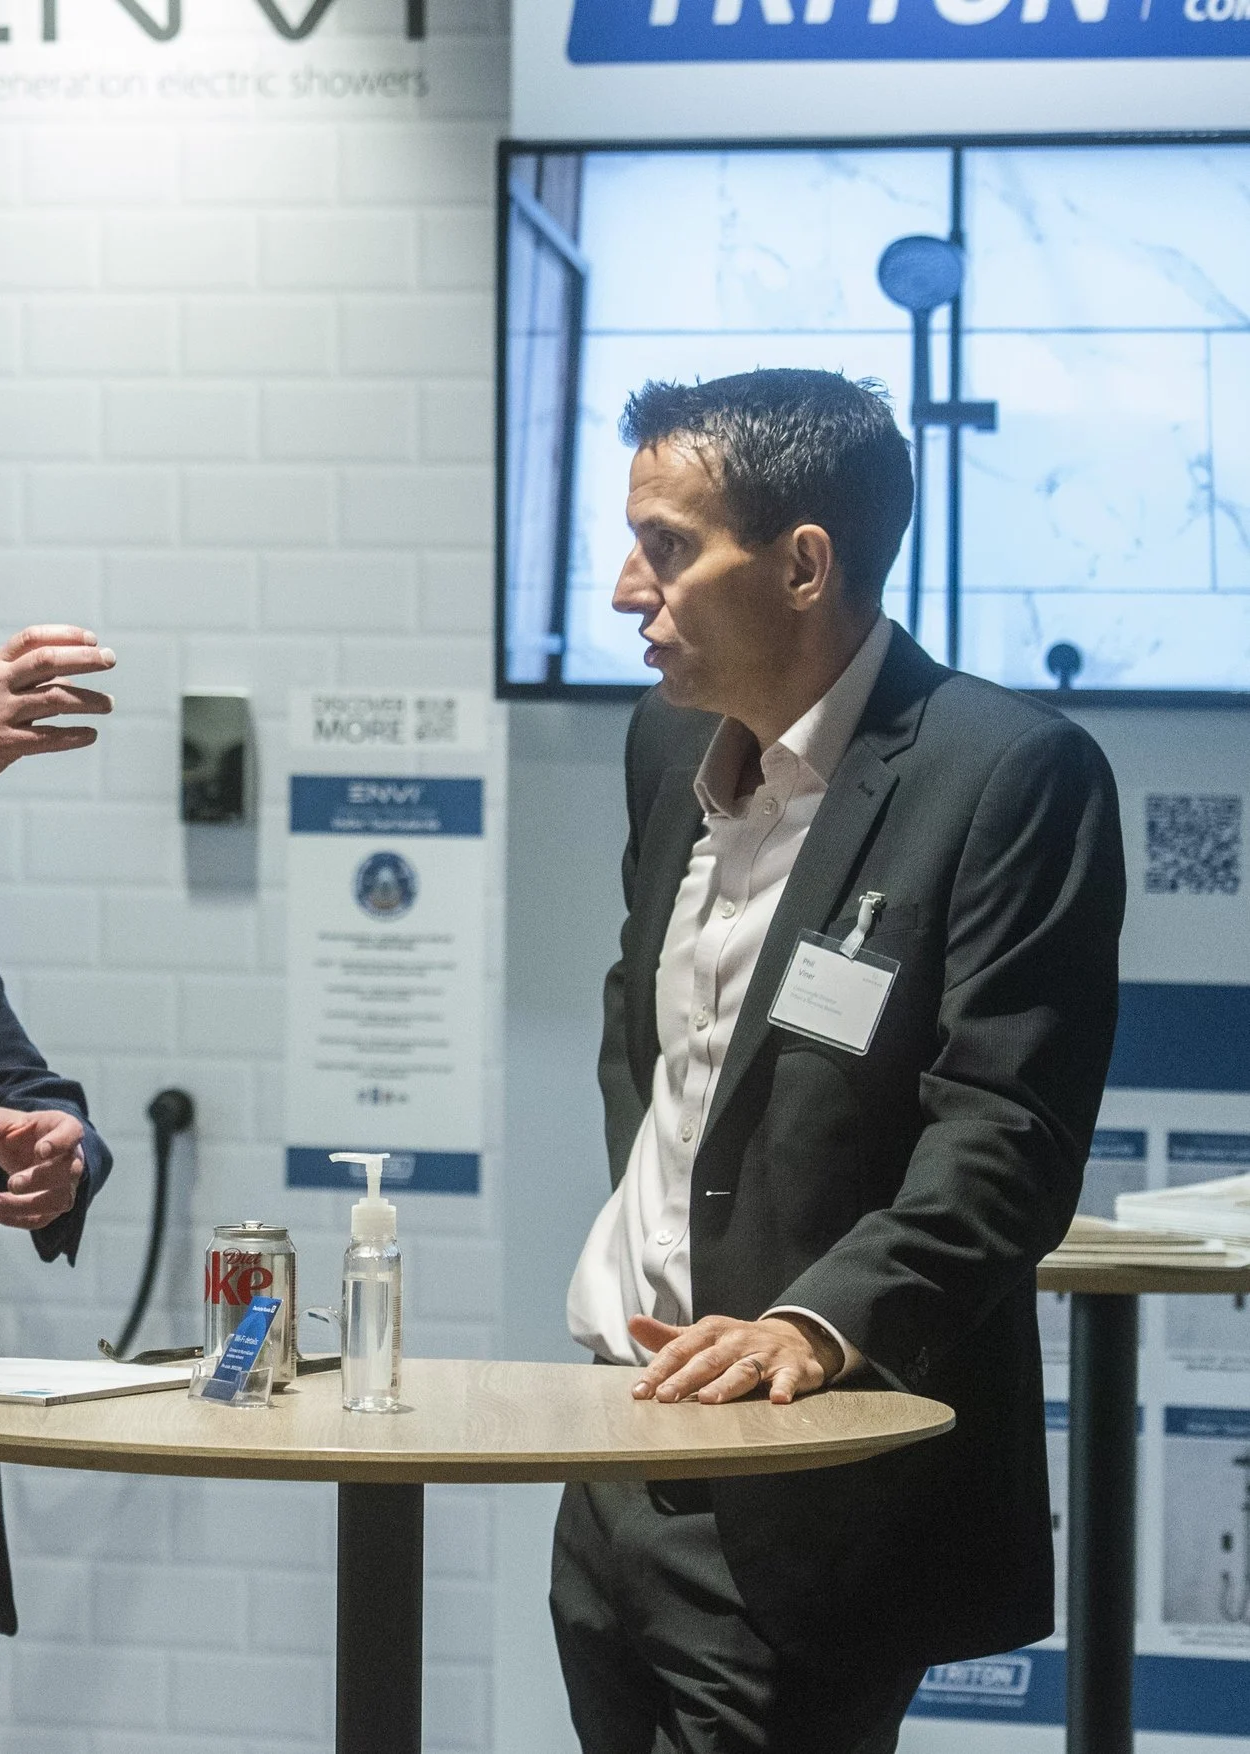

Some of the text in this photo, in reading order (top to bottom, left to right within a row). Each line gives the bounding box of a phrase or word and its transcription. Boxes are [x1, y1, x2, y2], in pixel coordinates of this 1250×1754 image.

[157, 64, 275, 98] electric
[287, 64, 431, 98] showers
[313, 719, 406, 744] MORE
[223, 1247, 262, 1264] Diet
[205, 1251, 273, 1305] ke
